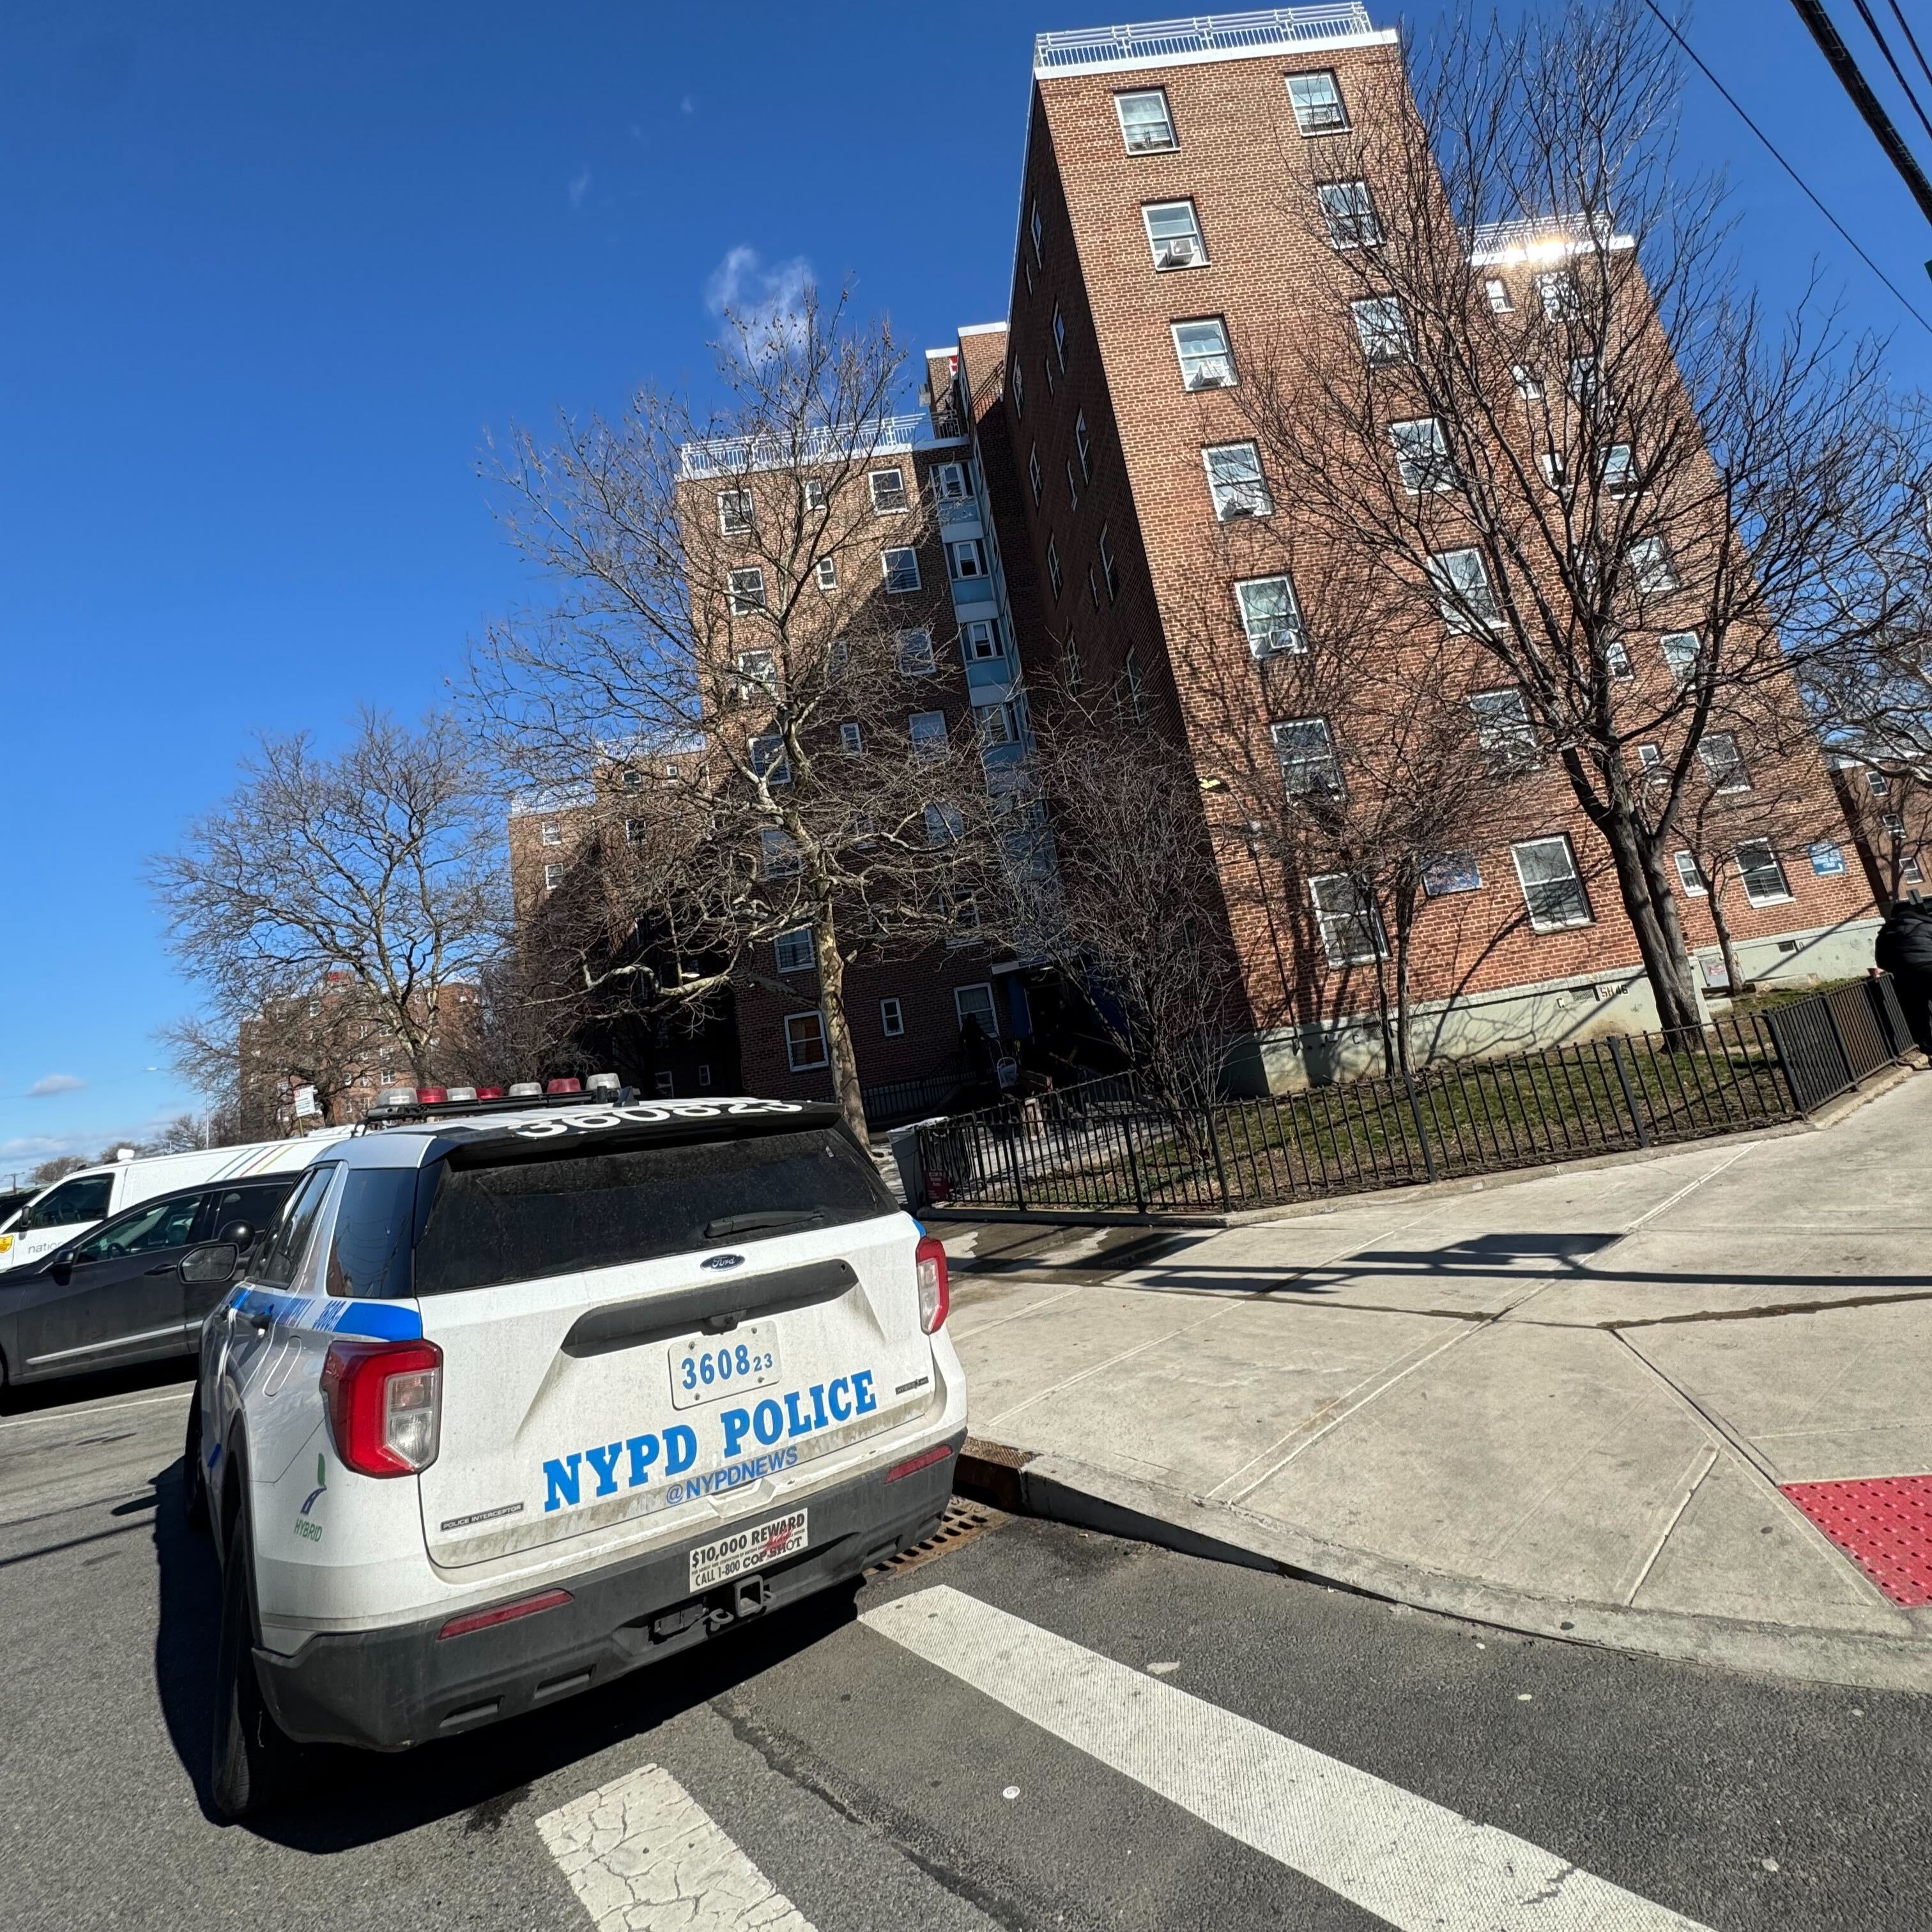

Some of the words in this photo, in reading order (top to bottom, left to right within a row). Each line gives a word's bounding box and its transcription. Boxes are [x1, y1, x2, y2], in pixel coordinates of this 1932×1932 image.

[509, 1101, 803, 1138] 360823
[712, 1256, 735, 1268] Ford
[542, 1424, 697, 1513] NYPD
[719, 1369, 877, 1459] POLICE
[666, 1445, 798, 1505] @NYPDNEWS
[294, 1517, 323, 1542] HYBRID
[442, 1517, 470, 1529] POLICE
[471, 1505, 521, 1522] INTERCEPTOR
[692, 1535, 747, 1569] $10,000
[751, 1513, 805, 1545] REWARD
[695, 1569, 716, 1587] CALL
[718, 1559, 740, 1579] 1-800
